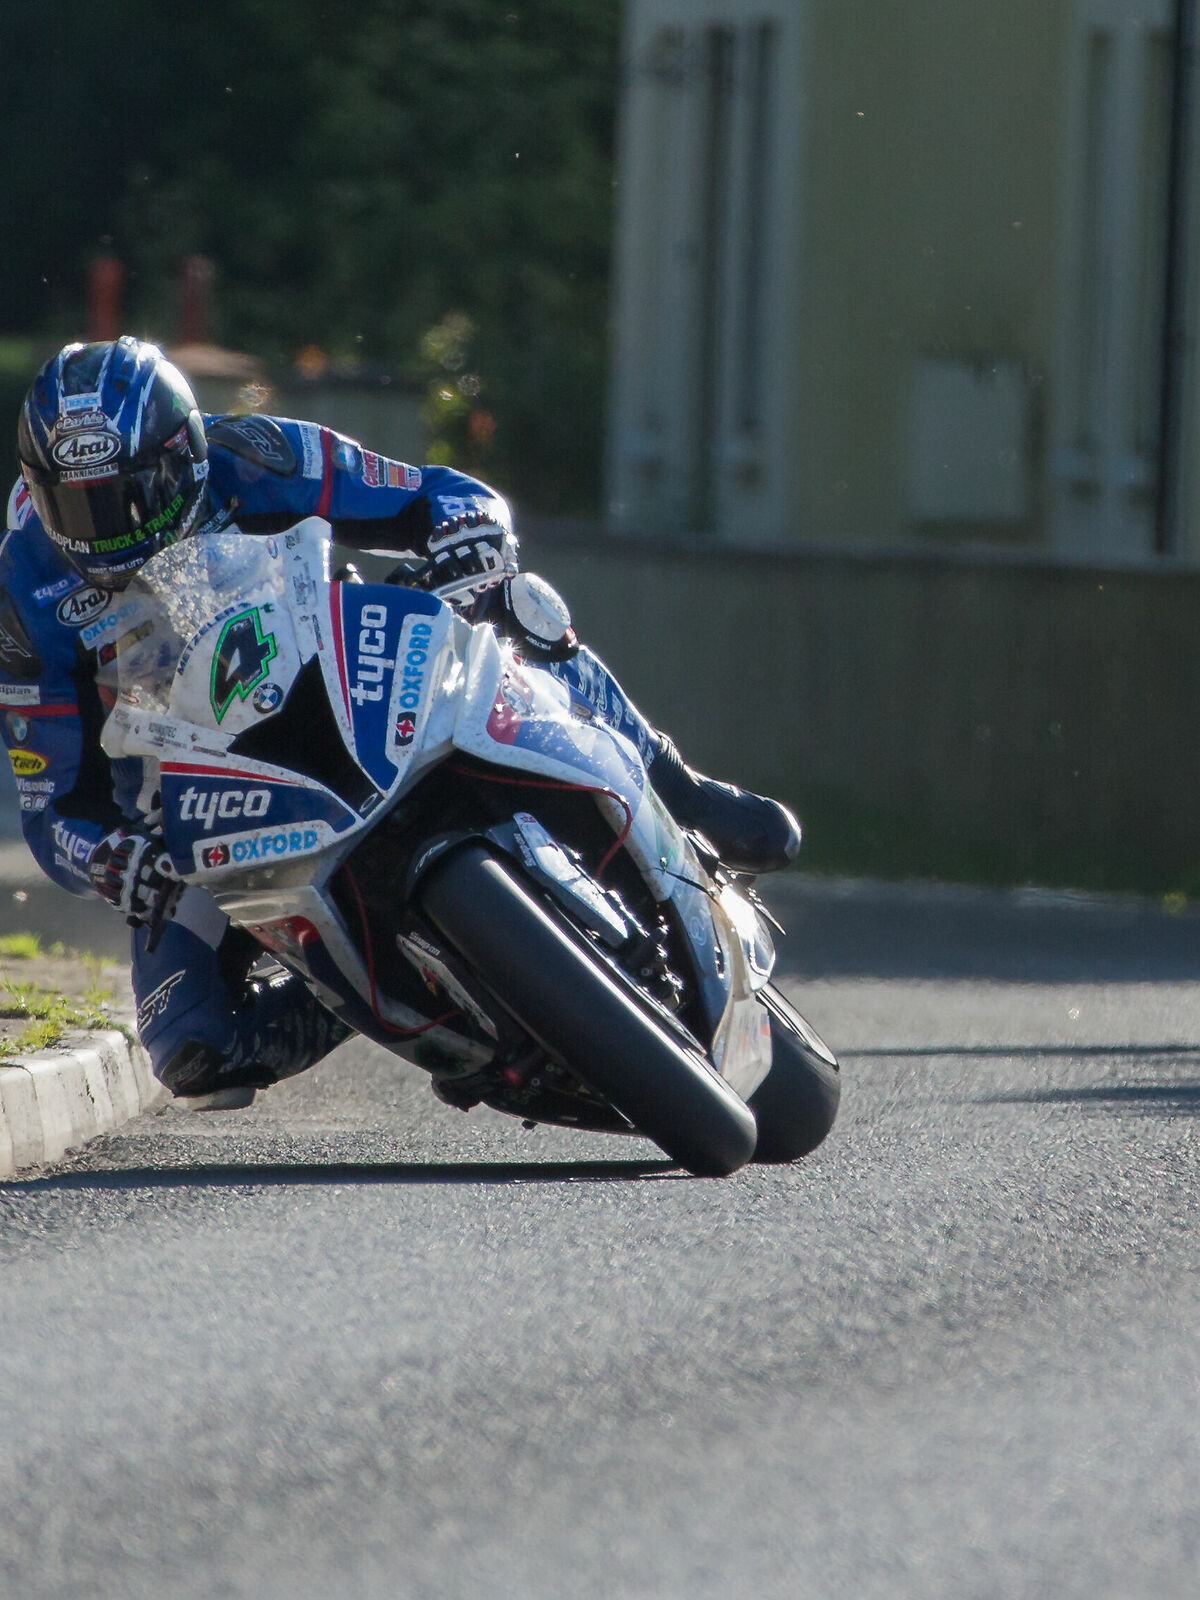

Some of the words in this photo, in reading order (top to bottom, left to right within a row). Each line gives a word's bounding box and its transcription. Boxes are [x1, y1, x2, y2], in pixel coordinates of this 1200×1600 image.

[59, 436, 111, 461] Arai
[92, 534, 135, 554] TRUCK
[136, 527, 146, 542] &
[144, 493, 185, 534] TRAILER
[33, 578, 69, 600] tyco
[82, 602, 139, 642] OXFORD
[209, 606, 278, 724] 4
[350, 604, 395, 707] tyco
[399, 622, 433, 710] OXFORD
[179, 785, 272, 831] tyco
[231, 829, 319, 863] OXFORD
[137, 969, 187, 1034] ST
